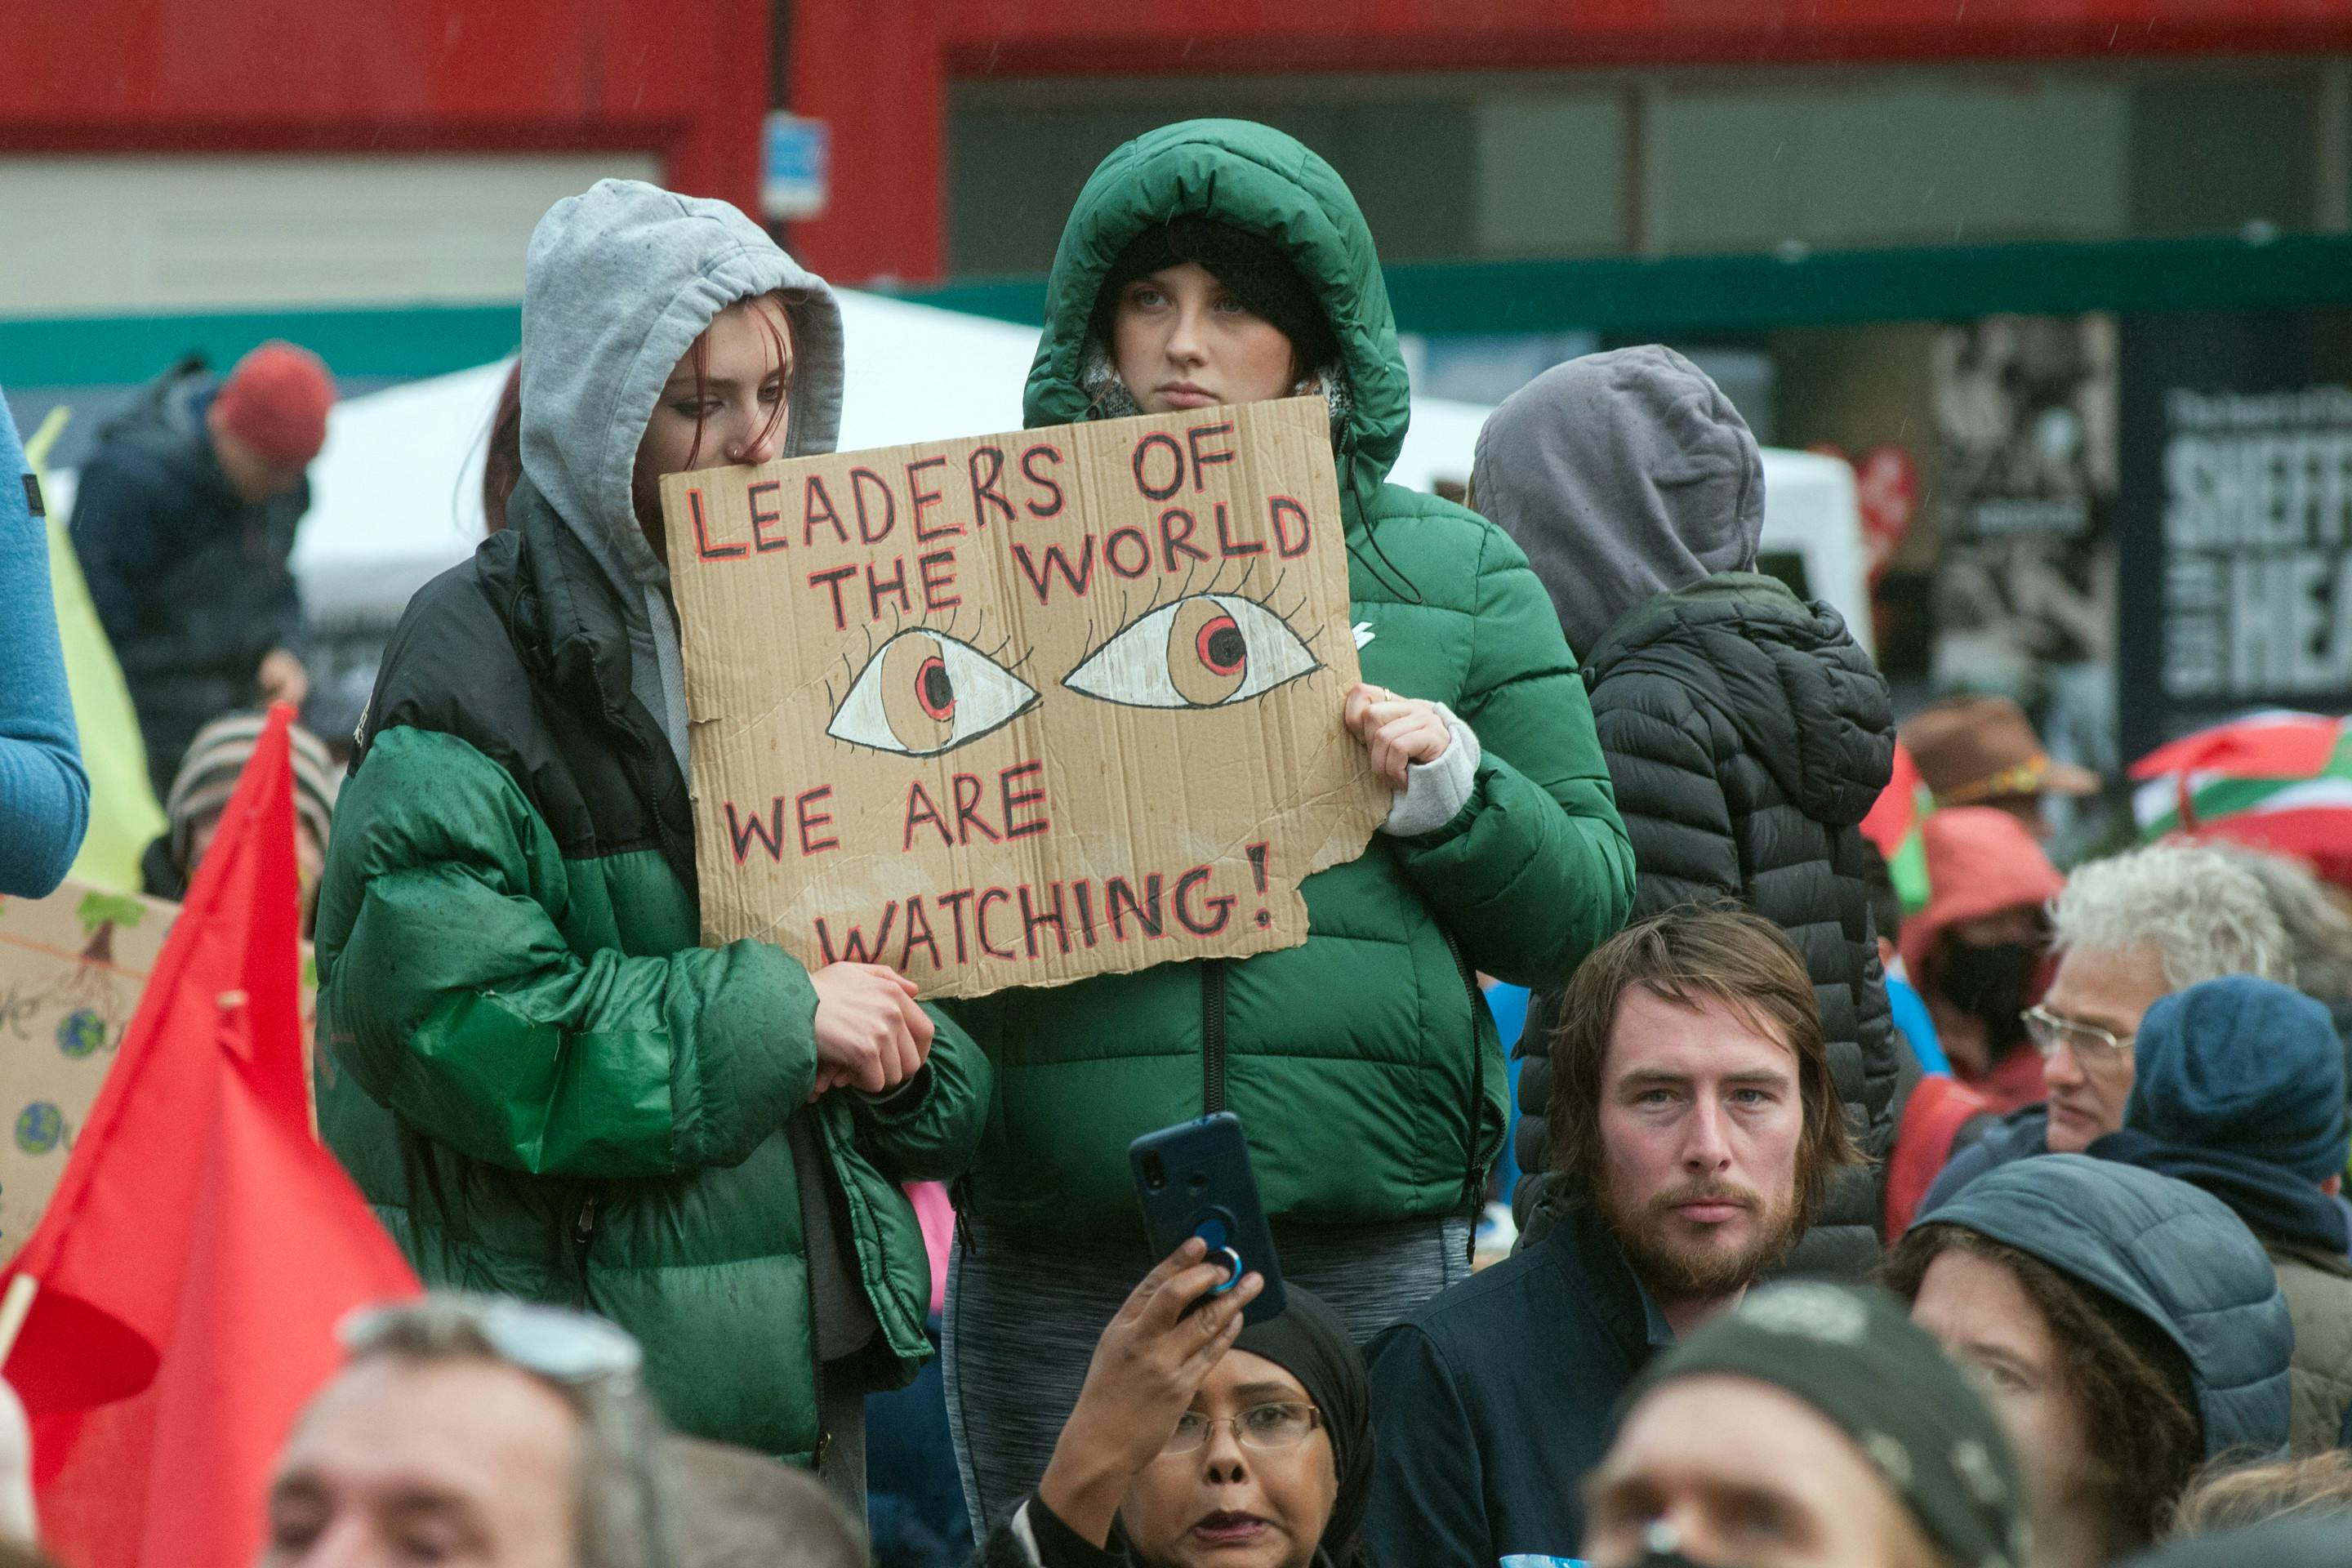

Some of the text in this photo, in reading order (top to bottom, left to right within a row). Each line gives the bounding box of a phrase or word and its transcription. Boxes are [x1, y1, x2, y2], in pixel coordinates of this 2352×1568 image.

[688, 420, 1236, 564] LEADERS OF
[808, 495, 1312, 633] THE WORLD
[724, 759, 1052, 866] WE ARE
[815, 840, 1272, 973] WATCHING!
